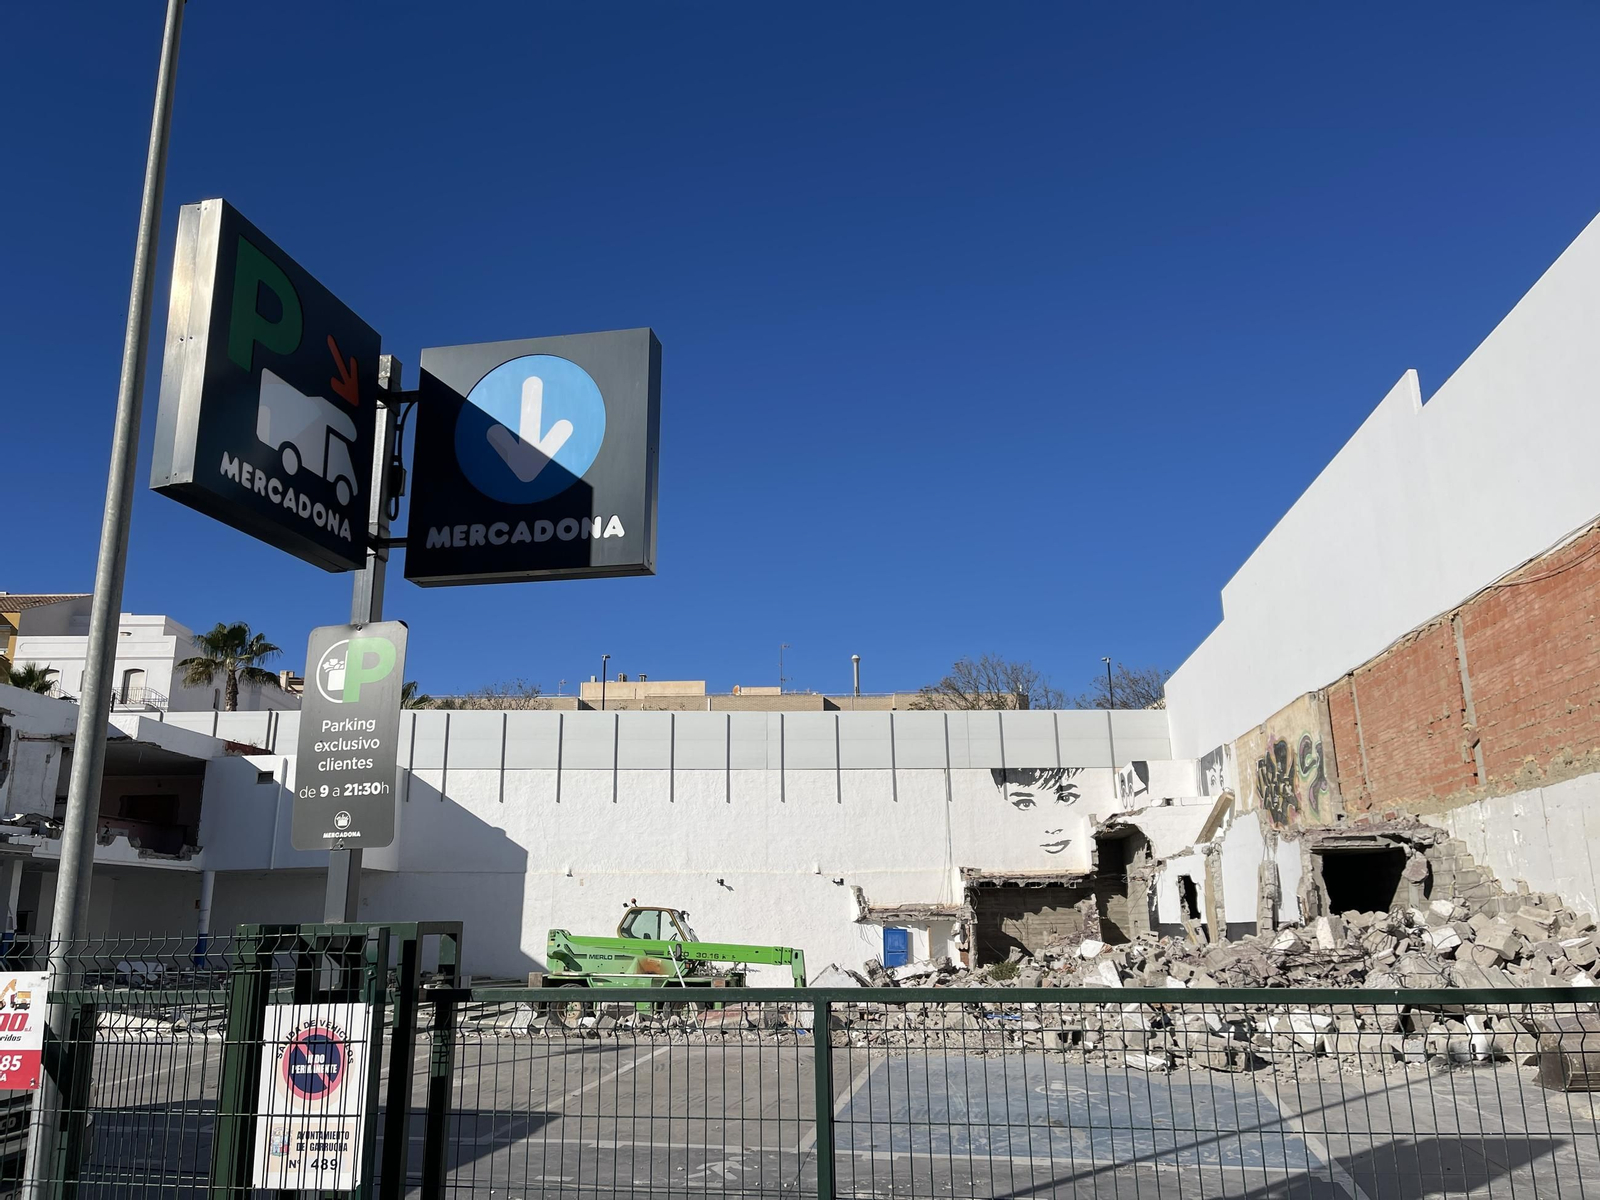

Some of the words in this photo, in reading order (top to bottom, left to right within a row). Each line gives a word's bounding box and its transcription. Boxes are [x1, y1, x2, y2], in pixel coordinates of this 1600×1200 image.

[227, 233, 303, 372] P
[219, 450, 352, 542] MERCADONA
[426, 514, 626, 549] MERCADONA
[342, 636, 397, 704] P
[321, 717, 376, 733] Parking
[314, 736, 380, 752] exclusivo
[318, 756, 373, 772] clientes
[299, 785, 316, 799] de
[319, 784, 329, 798] 9
[332, 786, 341, 797] a
[343, 781, 389, 797] 21:30h
[322, 830, 361, 839] MERCADONA
[276, 1026, 301, 1059] SAIDA
[303, 1019, 316, 1029] DE
[296, 1142, 305, 1152] DE
[310, 1158, 338, 1171] 489
